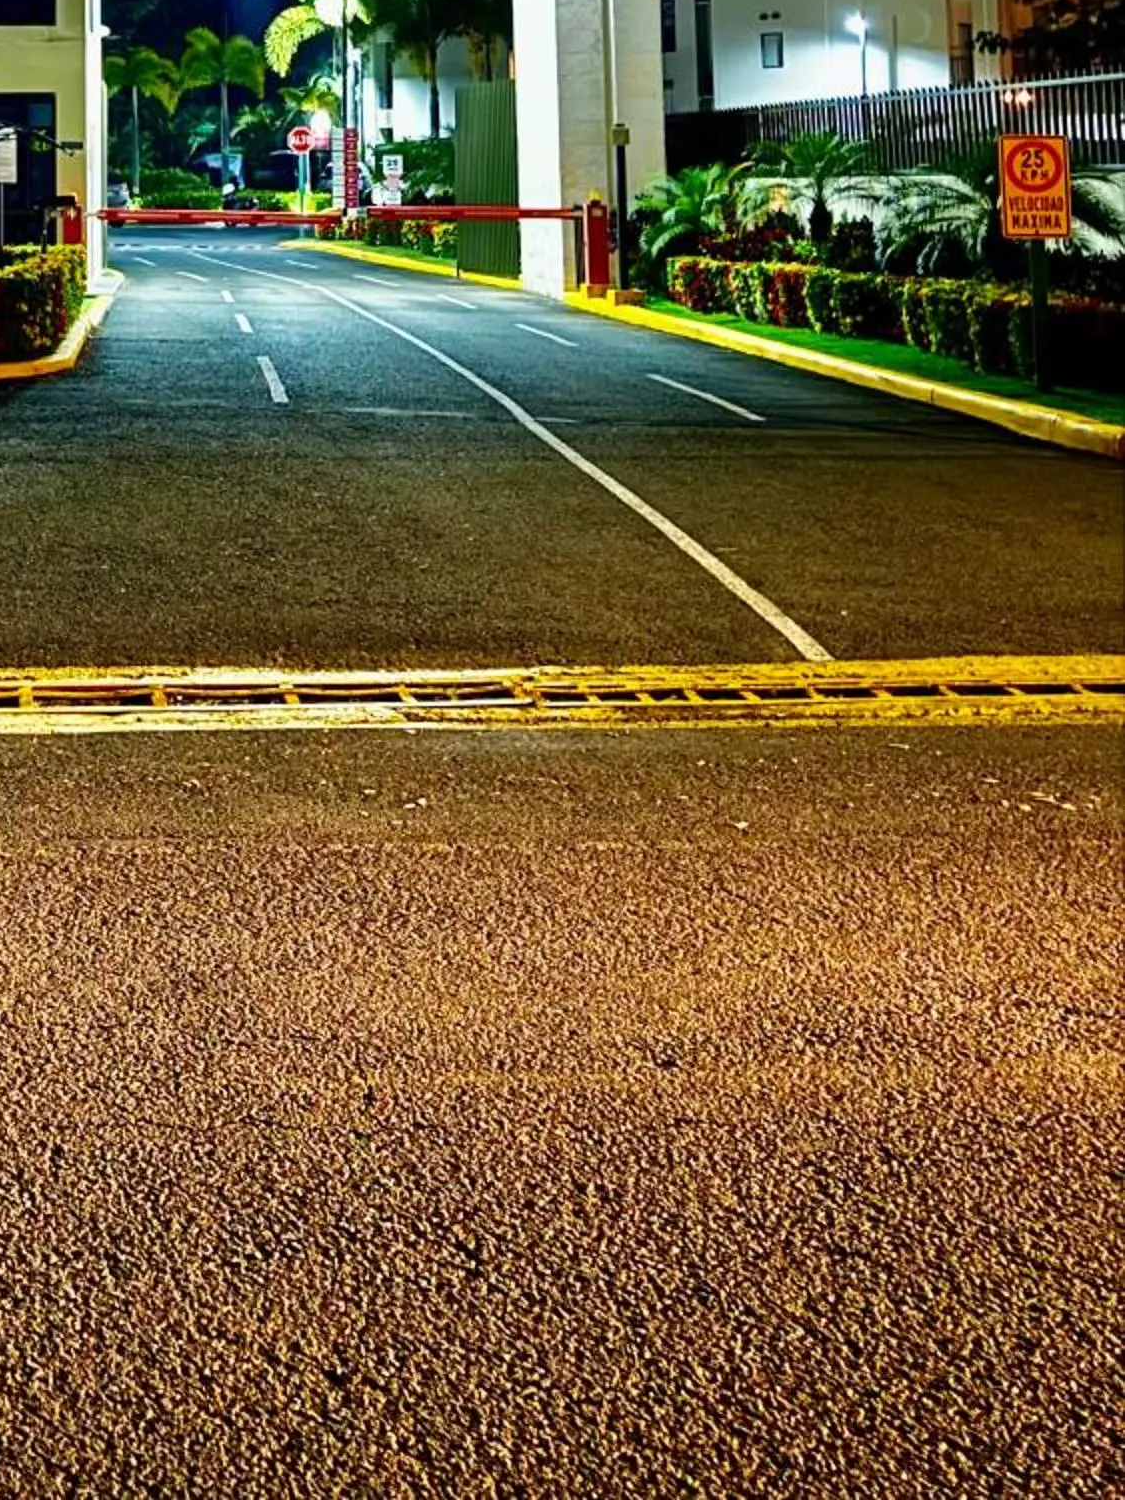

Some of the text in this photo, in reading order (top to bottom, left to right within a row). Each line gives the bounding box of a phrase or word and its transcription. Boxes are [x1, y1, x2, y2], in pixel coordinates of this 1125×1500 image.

[1020, 149, 1045, 169] 25
[1008, 196, 1064, 212] VELOCIDAD
[1012, 214, 1062, 229] MAXIMA
